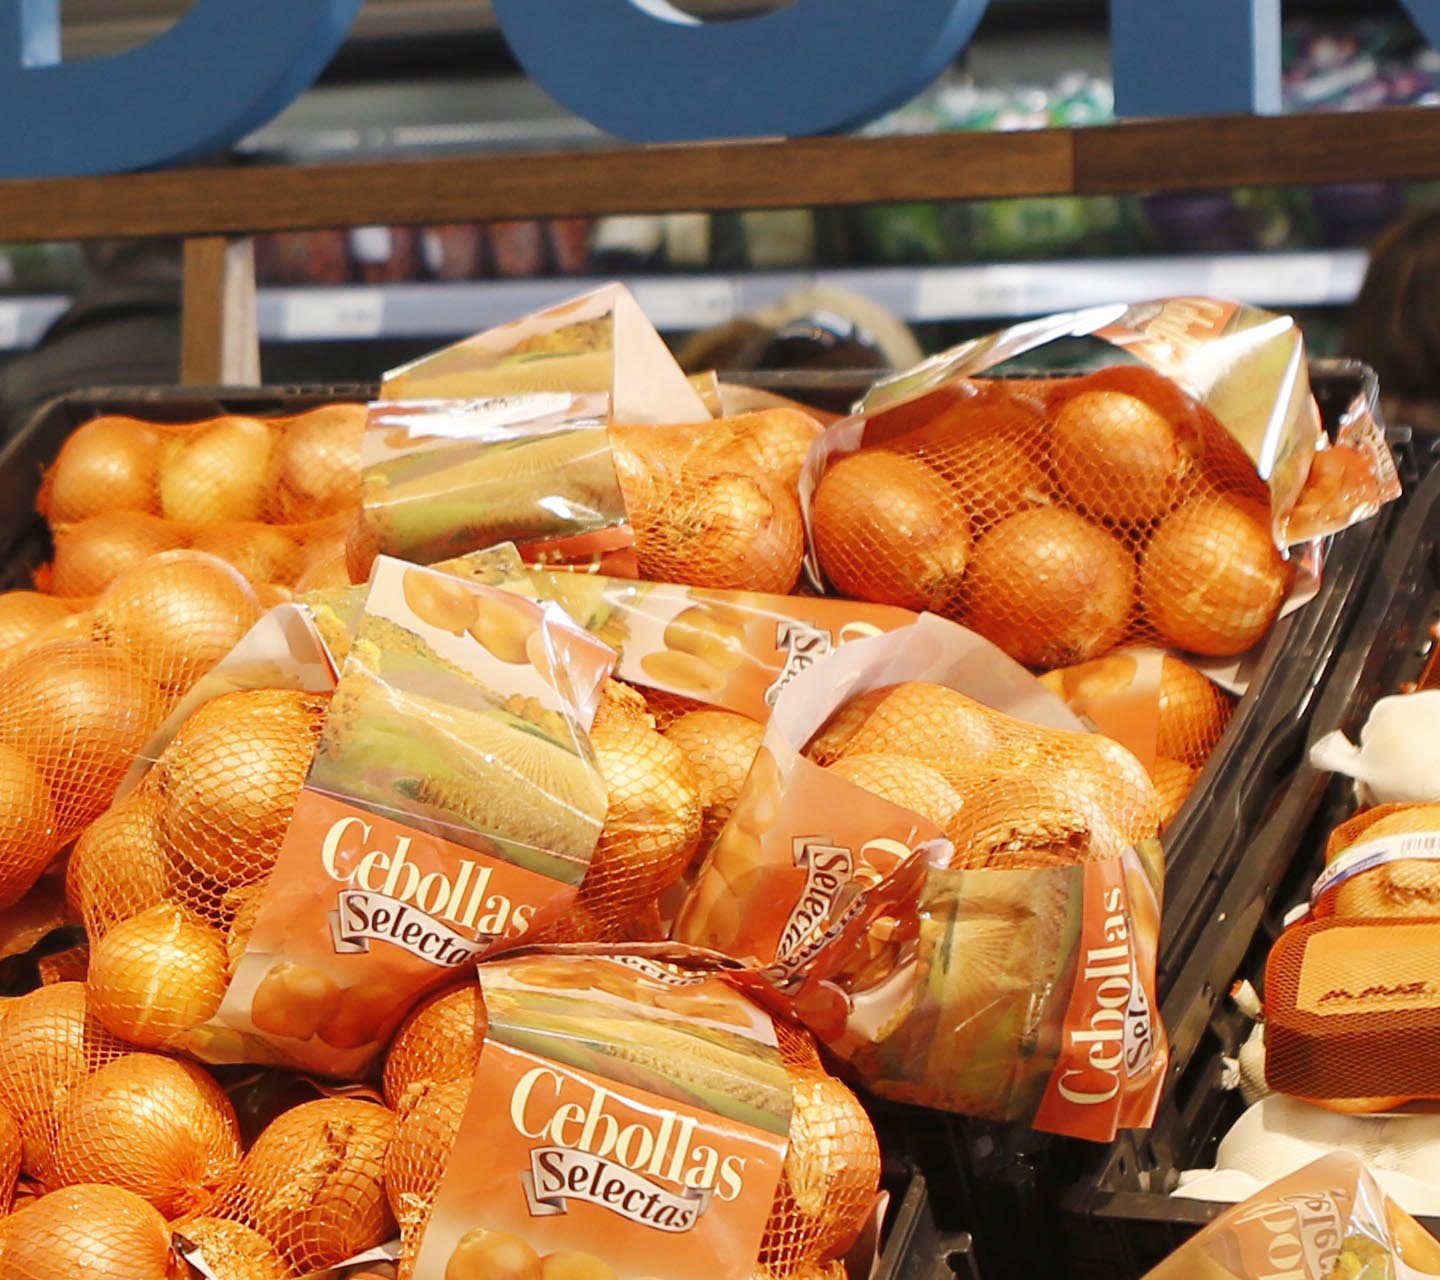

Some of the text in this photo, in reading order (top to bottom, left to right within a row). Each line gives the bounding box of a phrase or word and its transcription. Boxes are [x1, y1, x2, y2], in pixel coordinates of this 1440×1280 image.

[321, 816, 538, 940] Cebollas
[343, 893, 482, 967] Selecta
[1058, 886, 1129, 1106] Cebollas
[510, 1067, 747, 1202] Cebollas
[537, 1151, 696, 1231] Selectas
